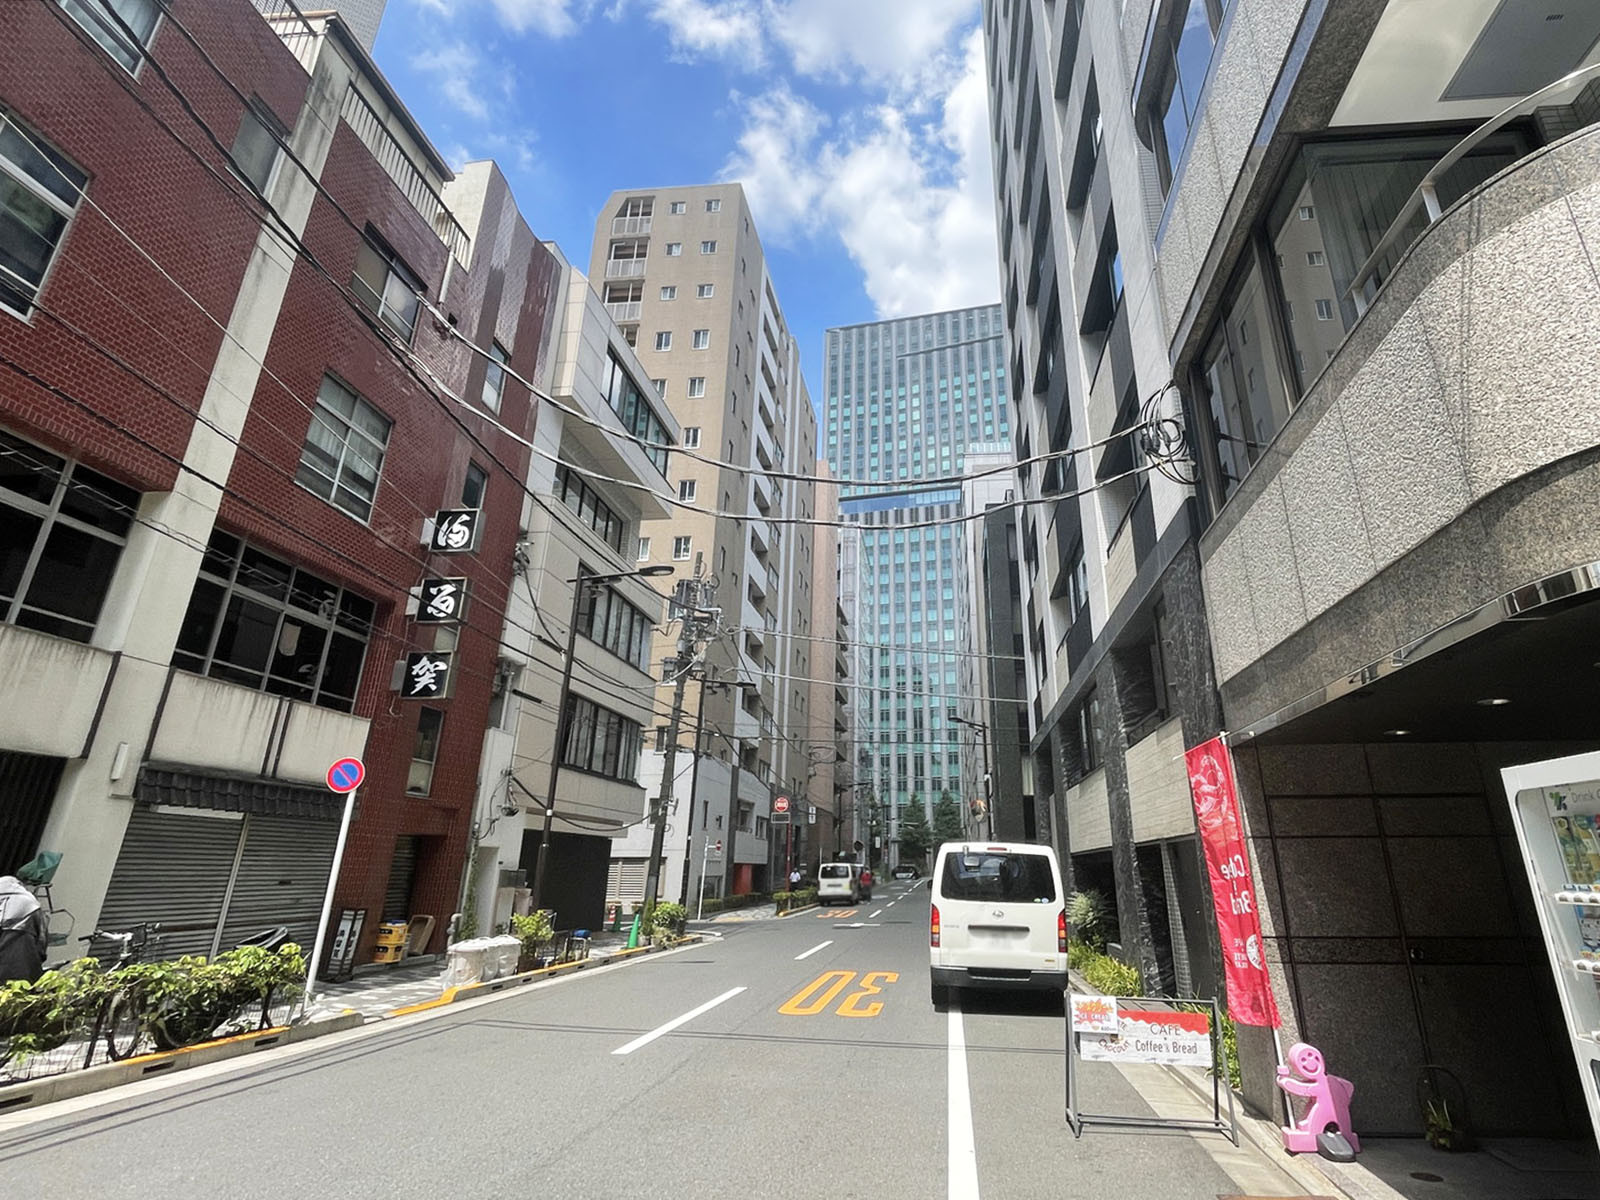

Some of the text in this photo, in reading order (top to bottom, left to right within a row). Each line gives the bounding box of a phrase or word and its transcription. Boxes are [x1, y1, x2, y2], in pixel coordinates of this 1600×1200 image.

[777, 970, 900, 1018] 30
[1150, 1023, 1181, 1036] CAFE
[1135, 1039, 1163, 1053] Coffee
[1172, 1041, 1198, 1054] Bread
